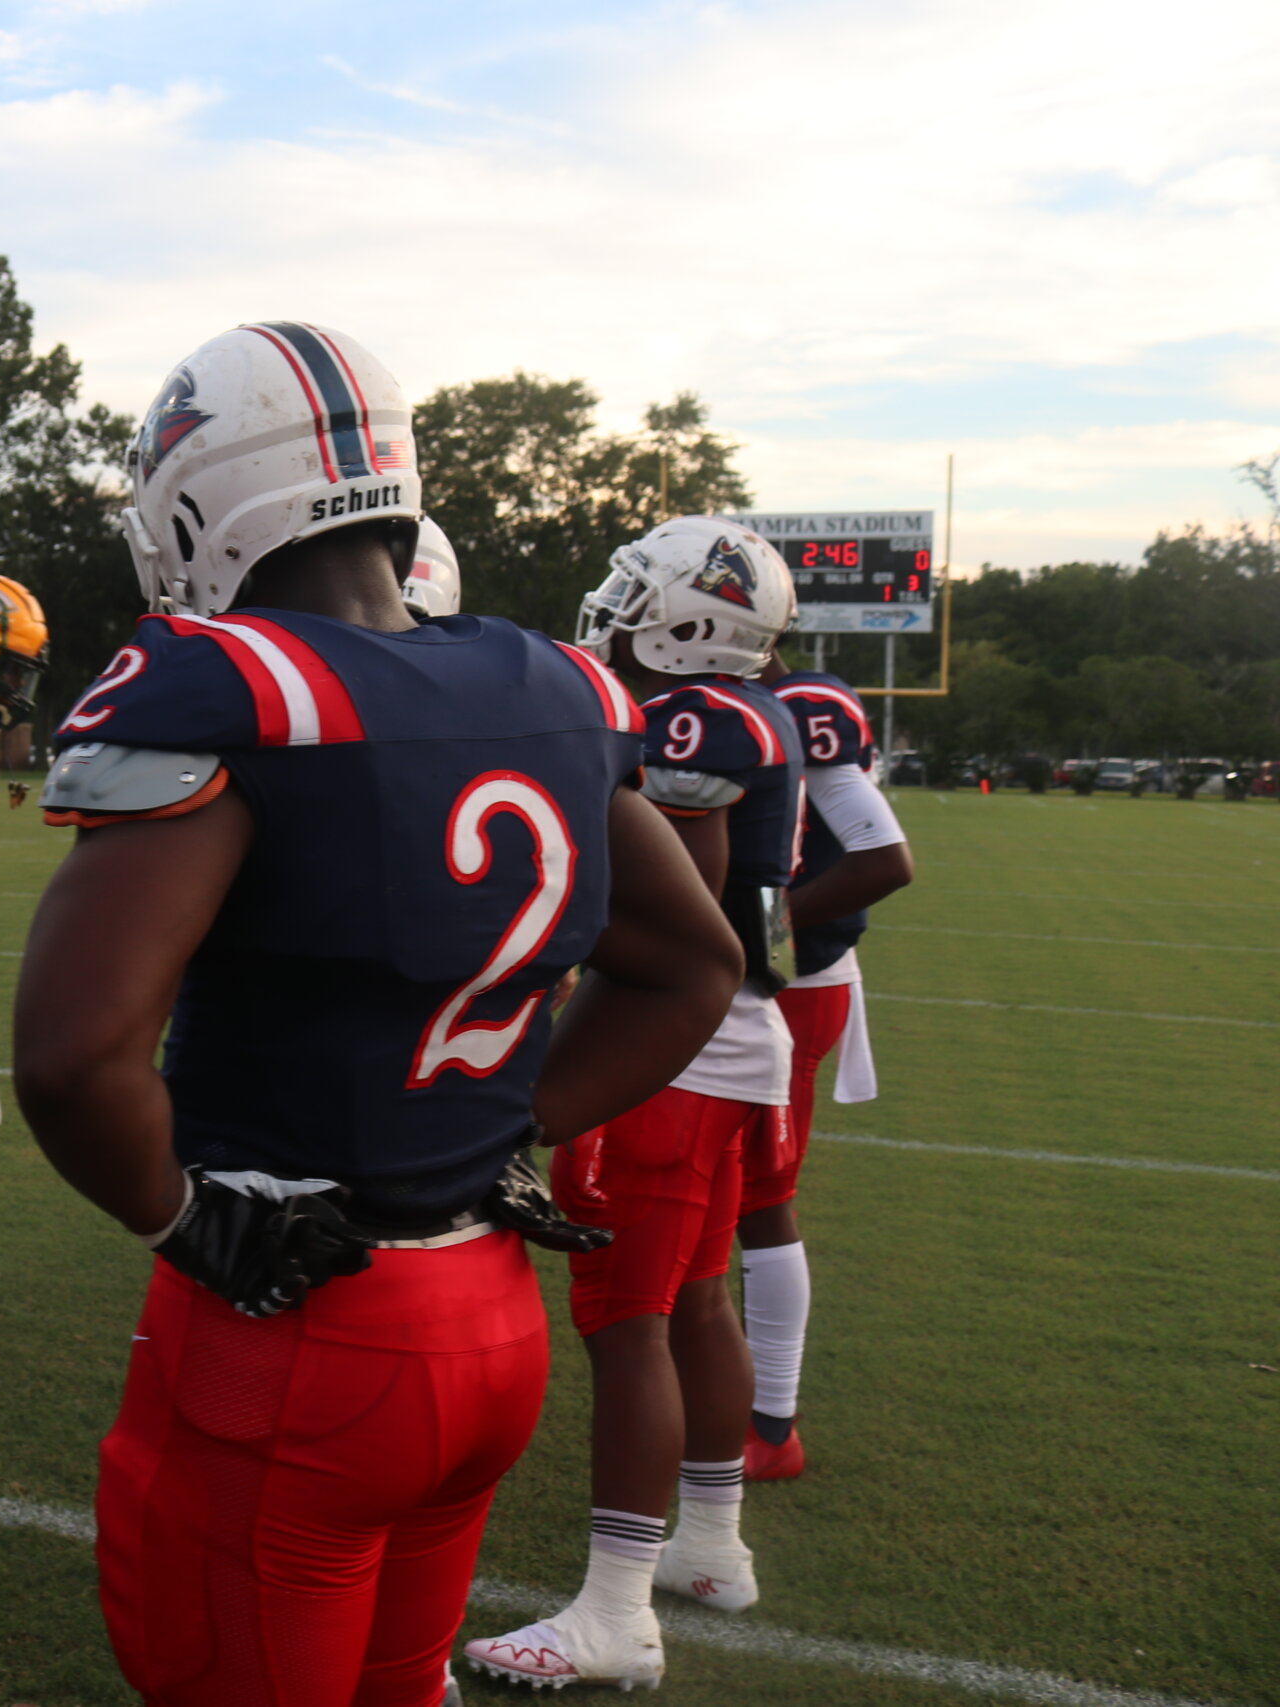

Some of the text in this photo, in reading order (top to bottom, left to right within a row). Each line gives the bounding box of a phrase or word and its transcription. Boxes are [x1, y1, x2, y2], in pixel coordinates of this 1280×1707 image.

[311, 484, 401, 521] schutt
[736, 515, 922, 534] YMPIA STADIUM
[802, 542, 859, 567] 2:46
[915, 550, 930, 571] 0
[883, 584, 892, 602] 1
[907, 574, 920, 592] 3
[56, 645, 149, 735] 2
[663, 711, 704, 761] 9
[807, 714, 841, 761] 5
[403, 769, 579, 1090] 2
